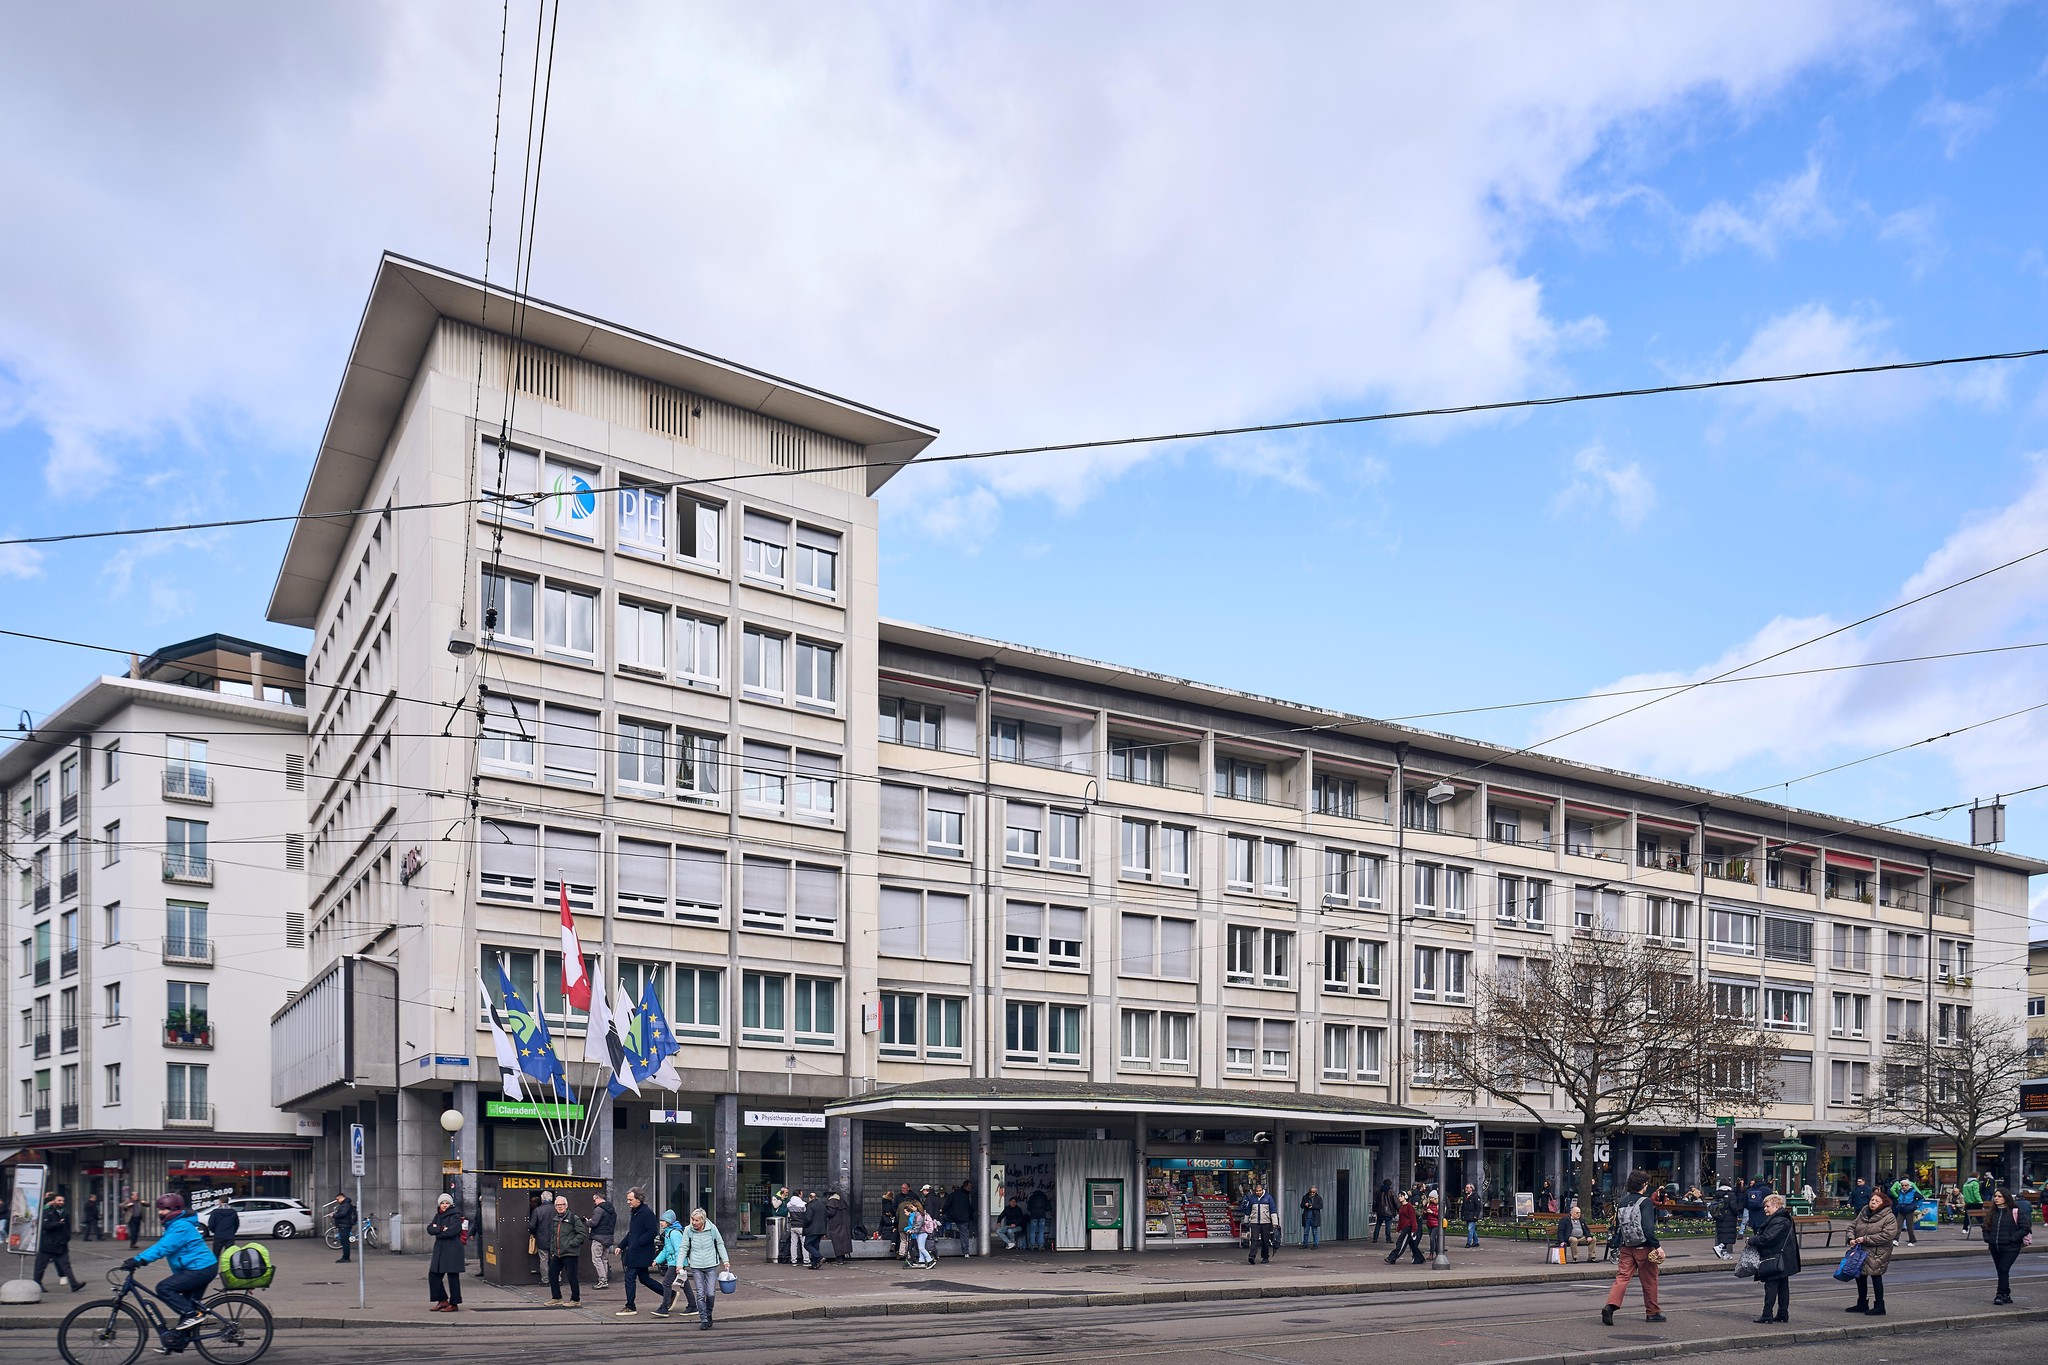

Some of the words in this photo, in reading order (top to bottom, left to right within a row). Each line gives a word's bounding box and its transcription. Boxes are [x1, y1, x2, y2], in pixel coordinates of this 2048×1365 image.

[499, 1106, 537, 1116] Claradent
[761, 1113, 793, 1123] Physiotherapie
[801, 1115, 823, 1124] Claraplatz
[188, 1160, 236, 1169] DENNER
[502, 1177, 541, 1189] HEISSI
[544, 1179, 603, 1189] MARRONI
